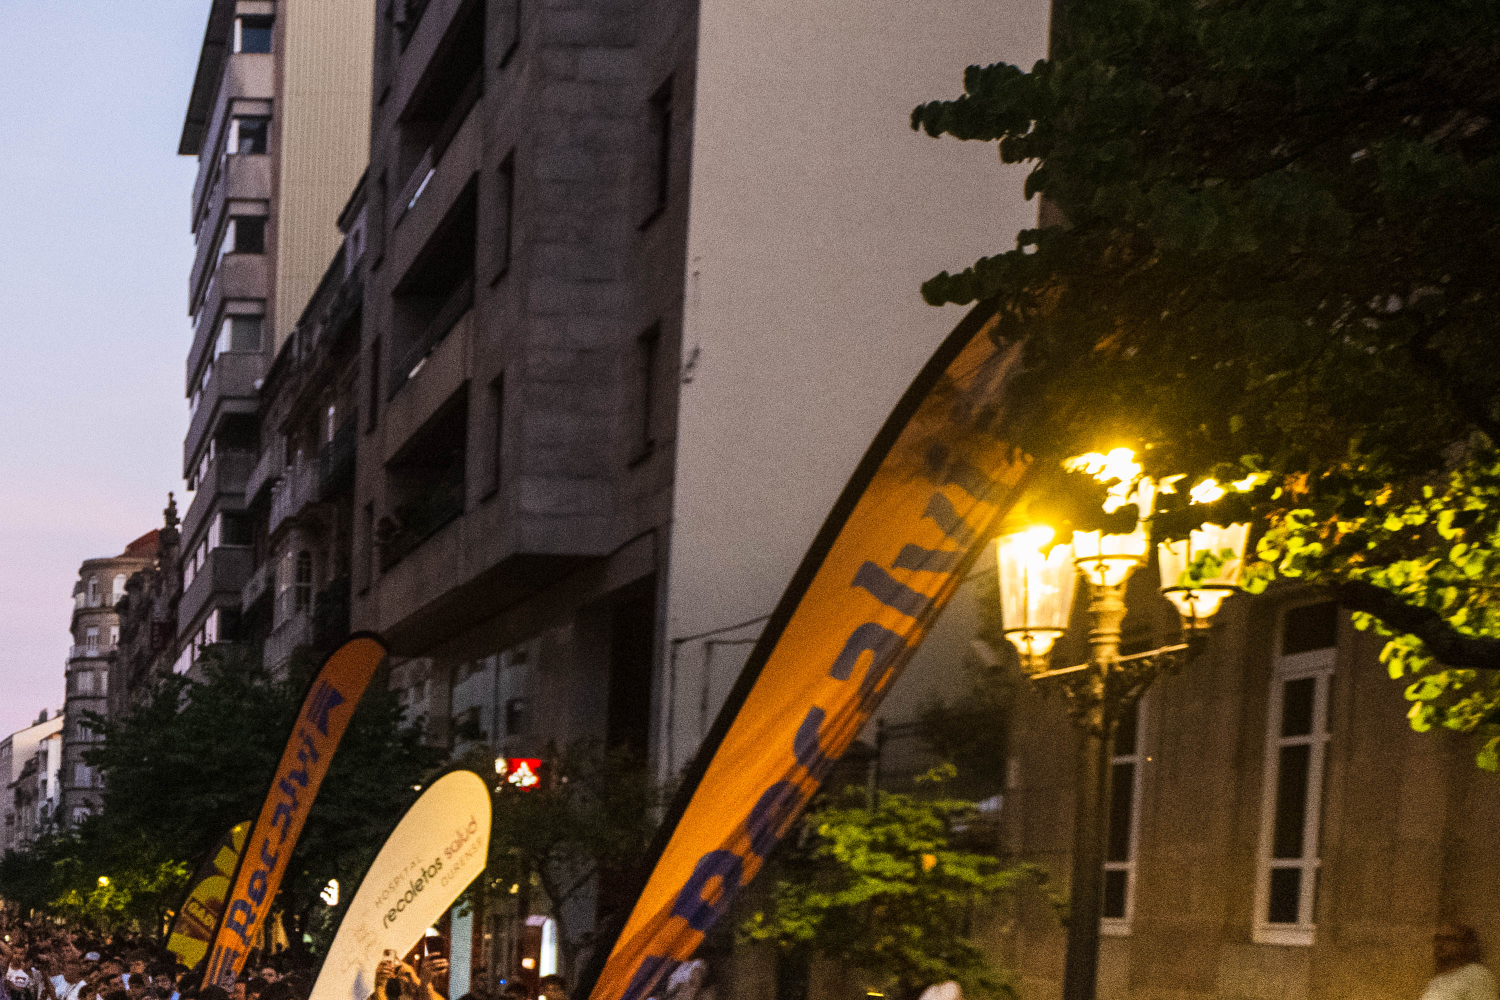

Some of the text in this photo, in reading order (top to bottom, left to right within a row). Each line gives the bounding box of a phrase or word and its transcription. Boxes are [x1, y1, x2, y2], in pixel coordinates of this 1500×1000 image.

[375, 856, 424, 908] HOSPITAL
[383, 814, 479, 930] recoletas salud
